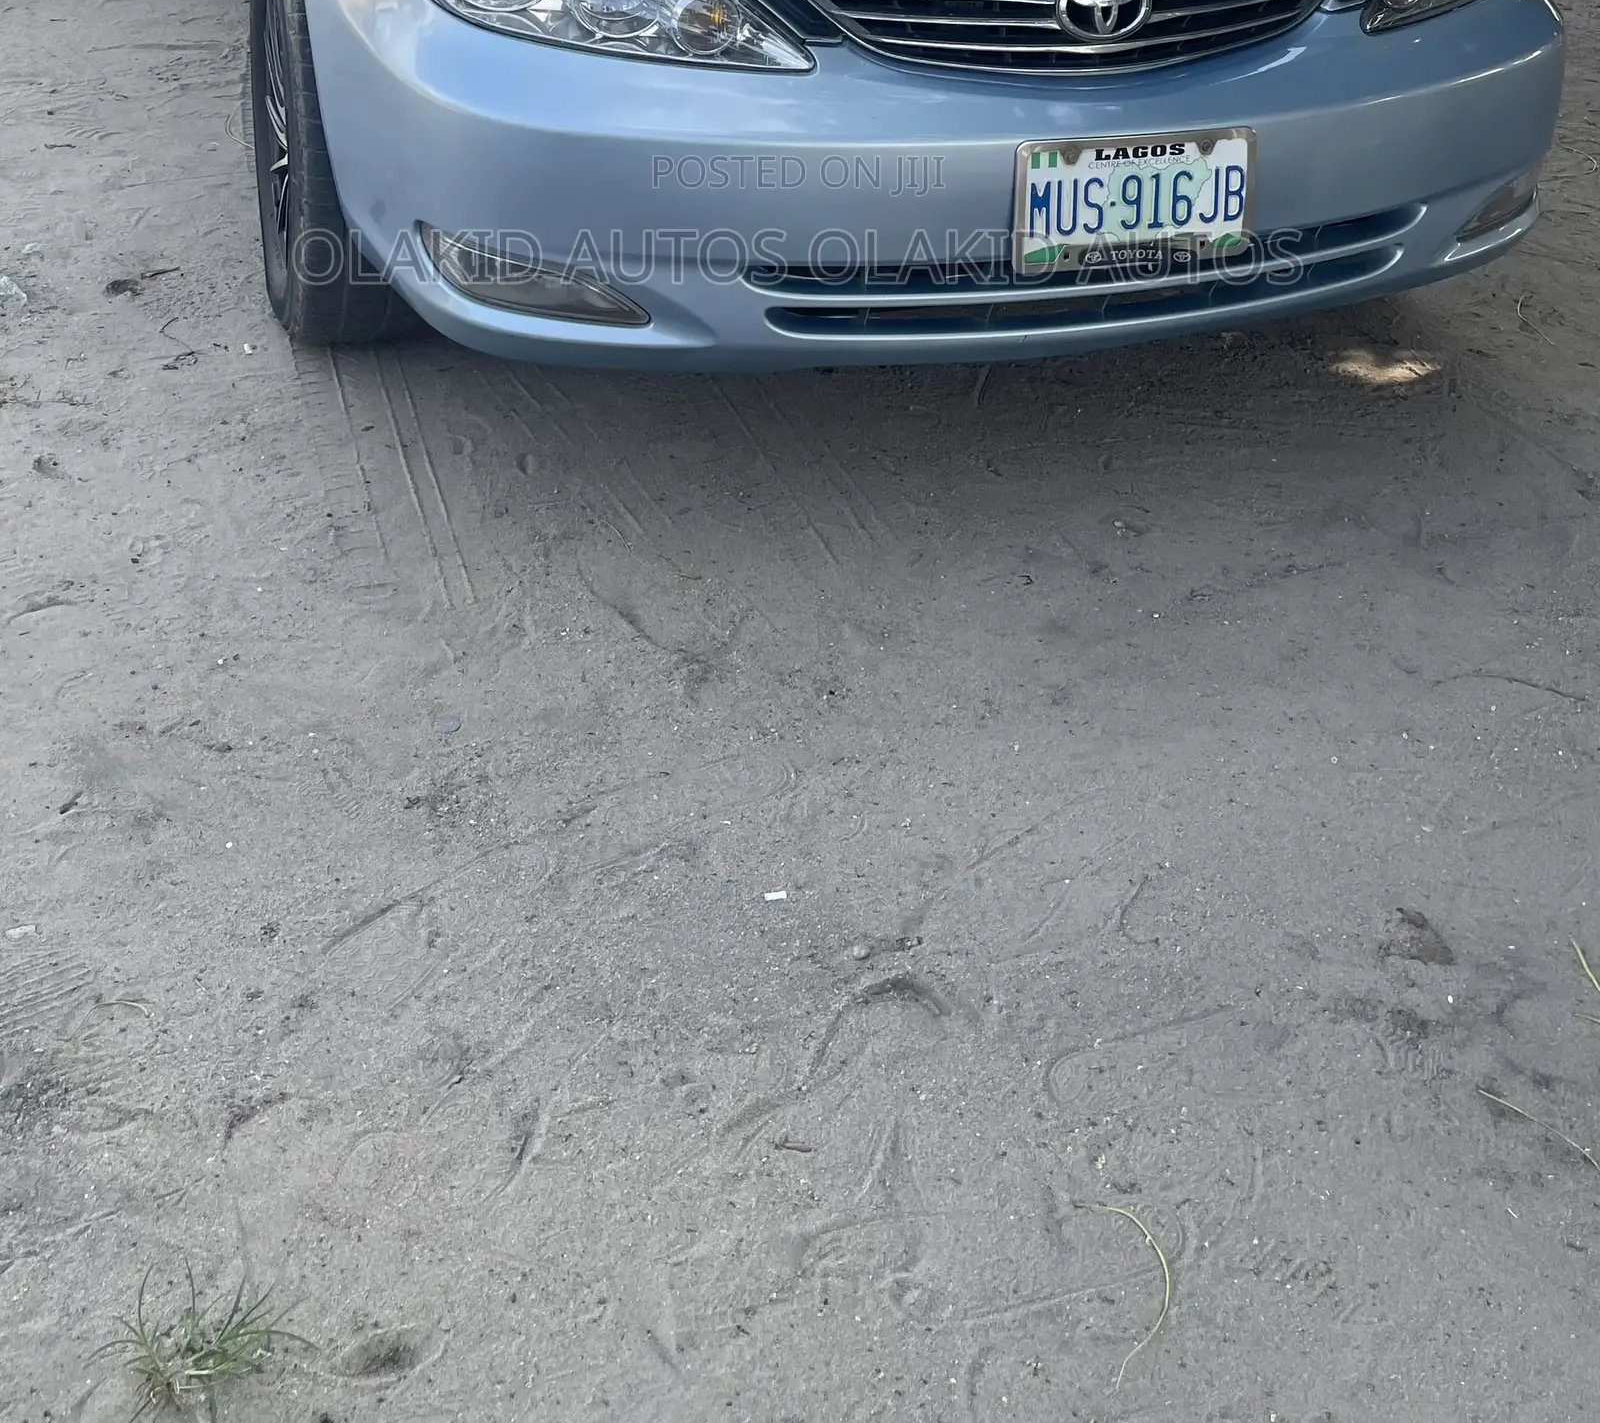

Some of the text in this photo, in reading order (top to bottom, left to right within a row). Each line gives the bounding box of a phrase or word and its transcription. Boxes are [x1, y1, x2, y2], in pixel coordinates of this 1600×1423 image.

[1095, 143, 1186, 161] LAGOS
[1088, 155, 1191, 170] CENTRE OF EXCELLENCE
[1110, 249, 1164, 261] TOYOTA
